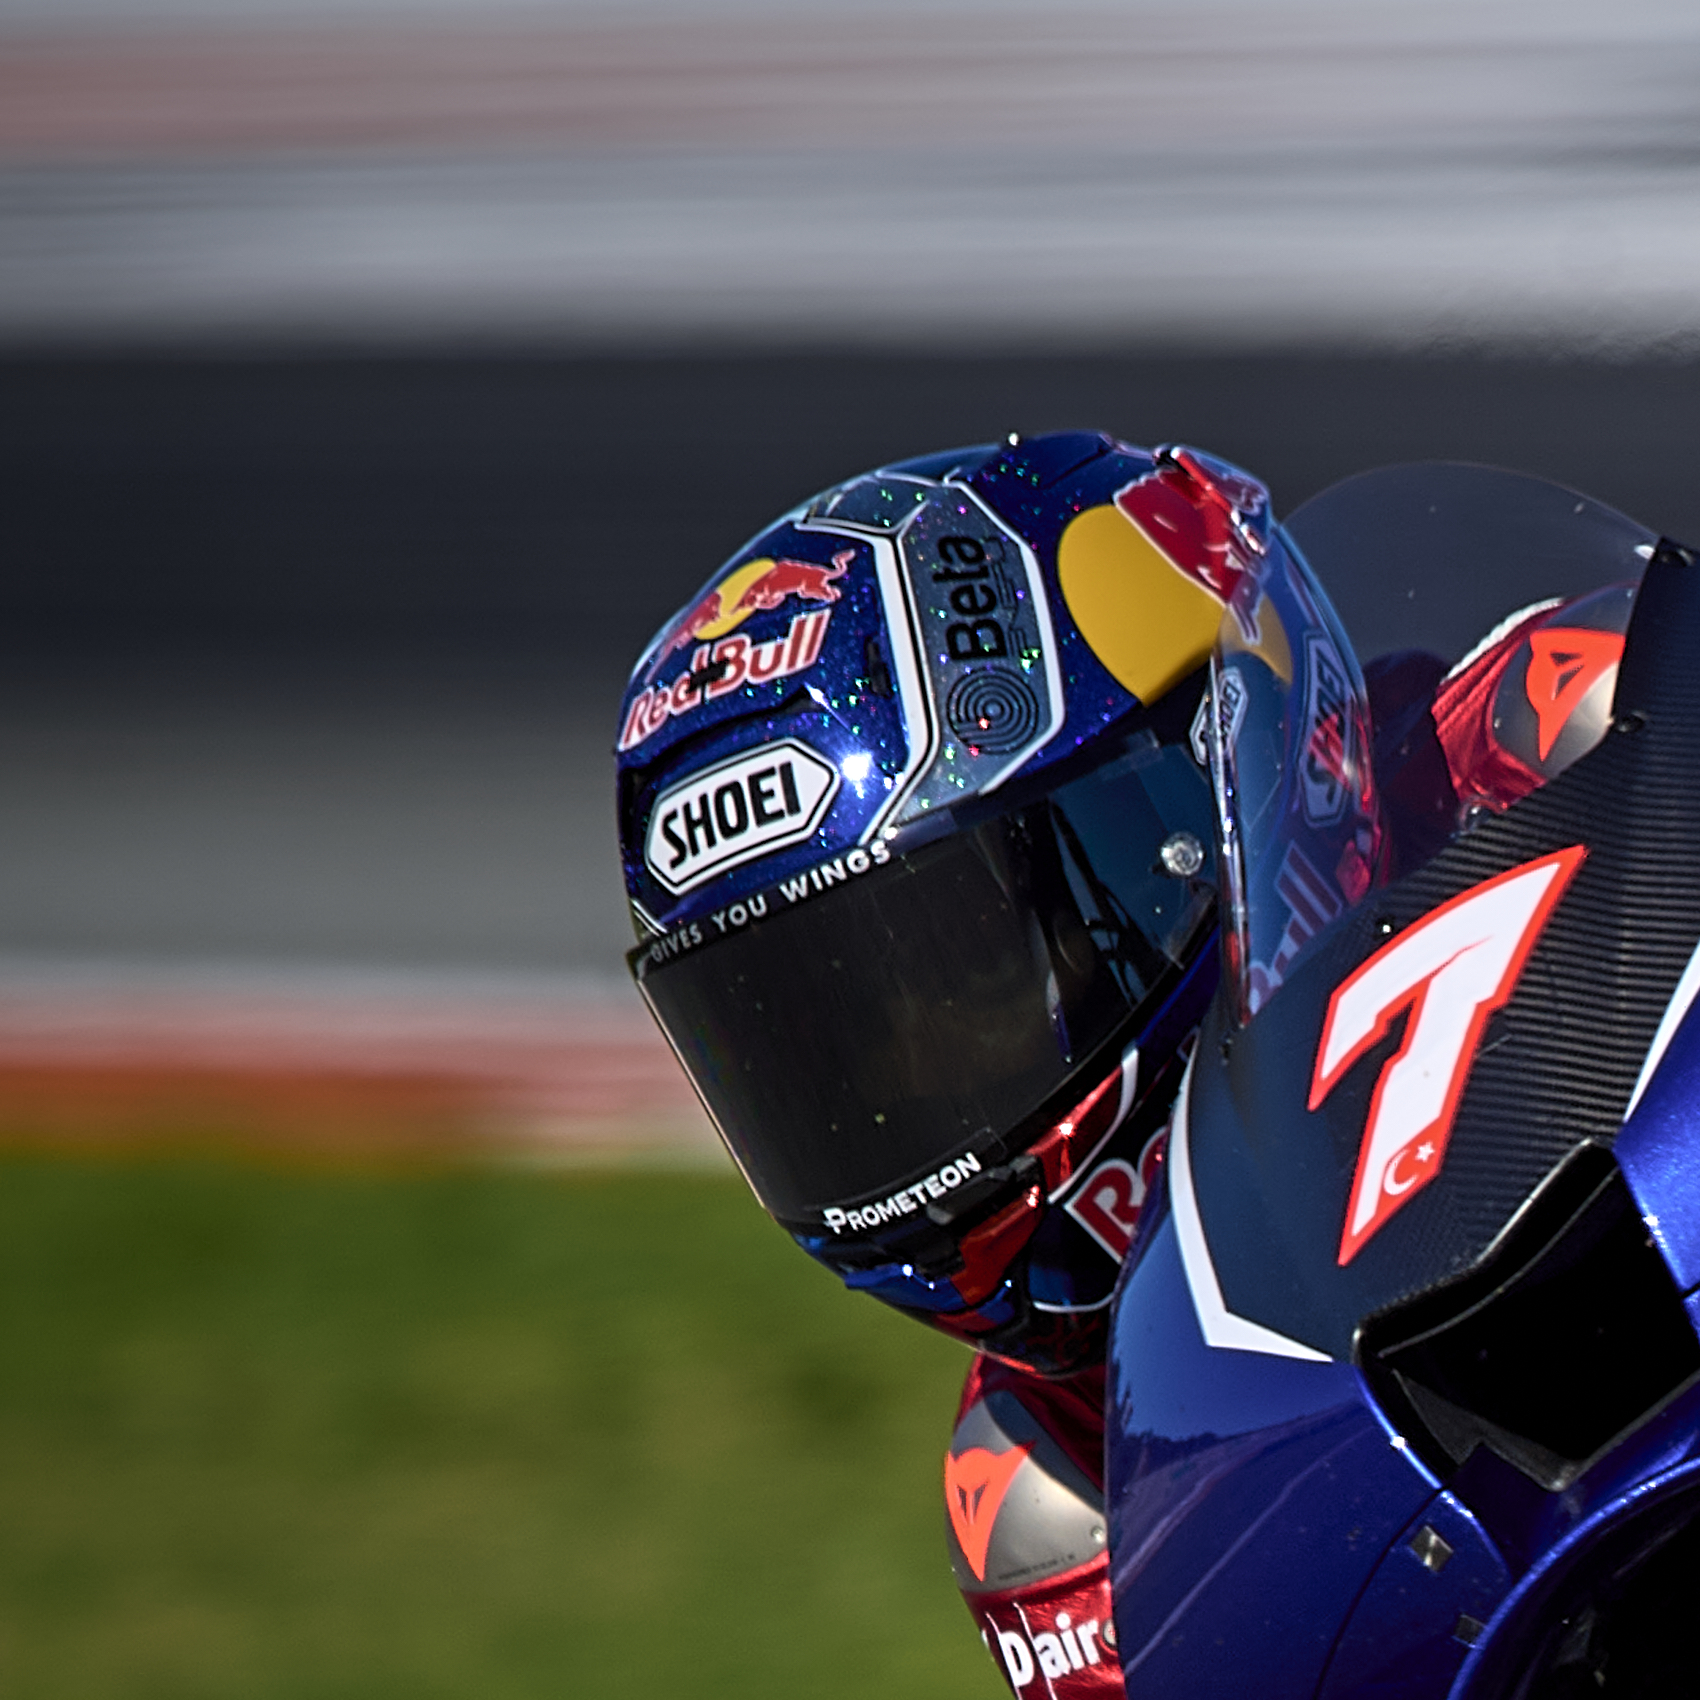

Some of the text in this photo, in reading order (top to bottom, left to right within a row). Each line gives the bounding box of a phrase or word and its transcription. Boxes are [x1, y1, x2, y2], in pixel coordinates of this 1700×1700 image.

[932, 536, 1008, 660] Beta
[618, 608, 832, 752] Red Bull
[661, 761, 802, 870] SHOEI
[650, 839, 891, 963] GIVES YOU WINGS
[1308, 845, 1587, 1266] 7
[823, 1151, 982, 1235] PROMETEON
